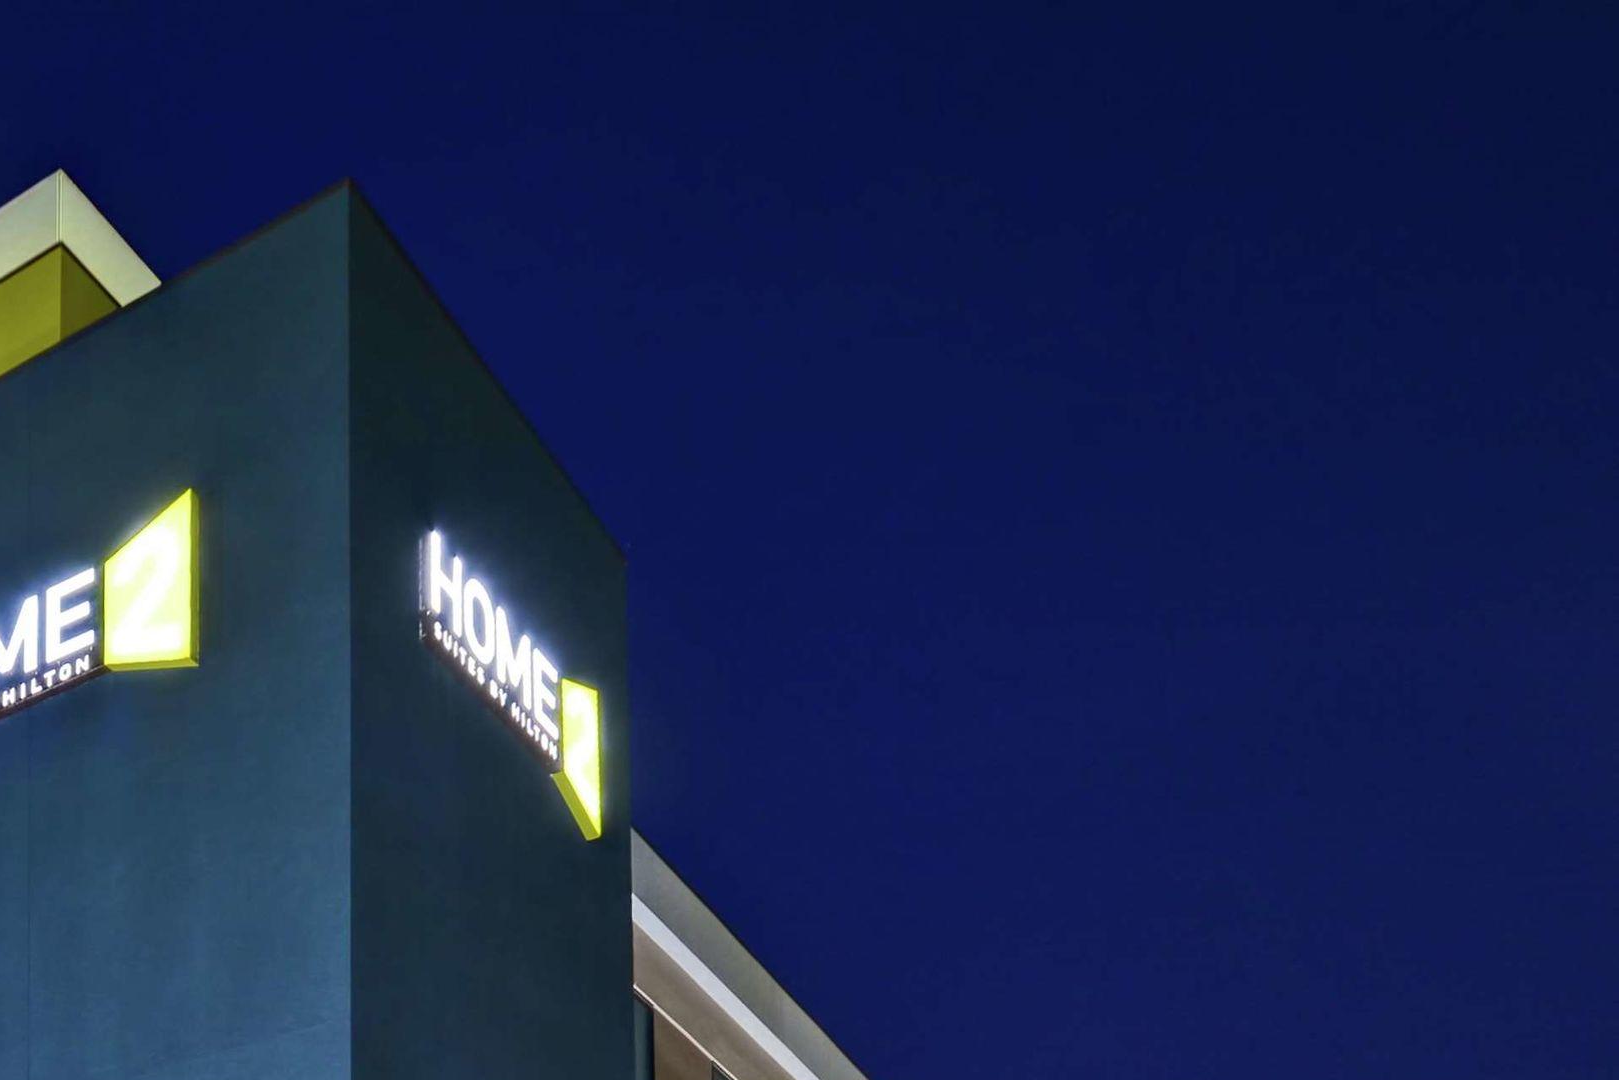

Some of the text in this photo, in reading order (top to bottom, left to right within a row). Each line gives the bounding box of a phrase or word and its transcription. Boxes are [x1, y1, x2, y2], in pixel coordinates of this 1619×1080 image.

[110, 520, 182, 656] 2
[426, 529, 559, 741] HOME
[1, 654, 91, 707] HILTON
[433, 620, 559, 760] SUITES BY HILTON
